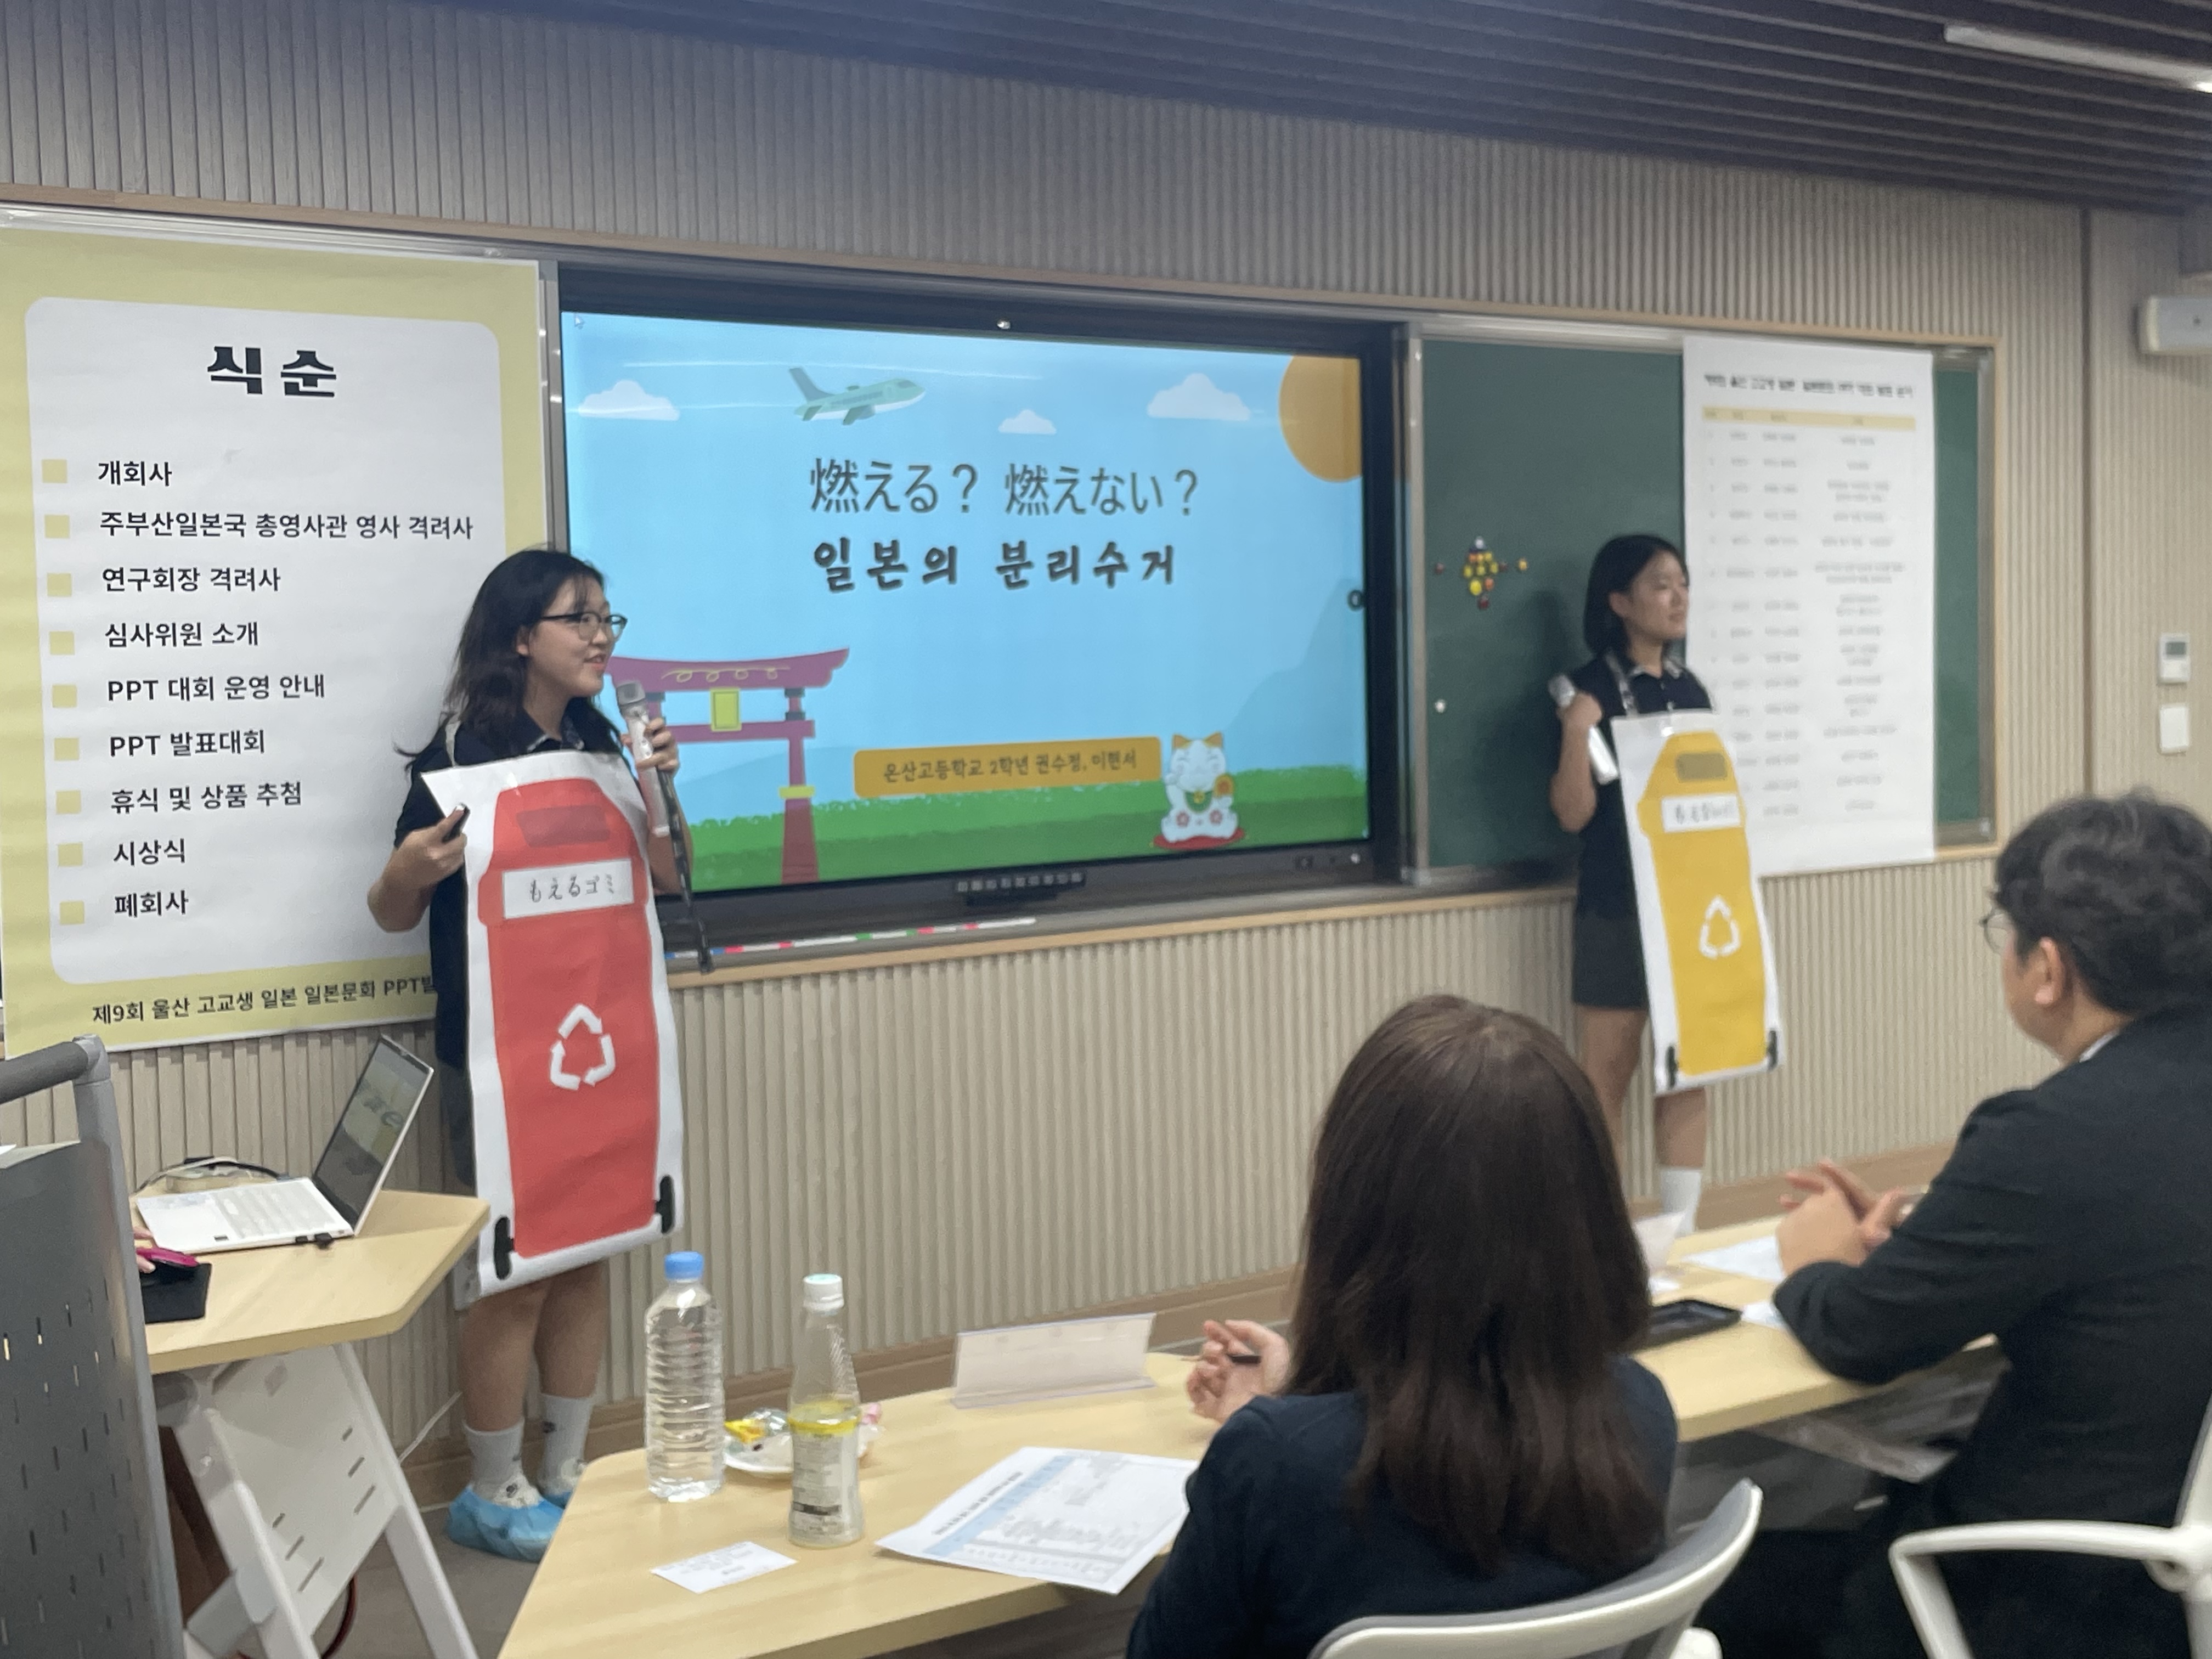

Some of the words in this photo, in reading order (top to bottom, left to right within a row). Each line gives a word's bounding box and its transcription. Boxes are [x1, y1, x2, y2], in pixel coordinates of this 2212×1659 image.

[98, 460, 172, 487] 개회사
[810, 458, 978, 513] 燃える？
[1005, 463, 1198, 516] 燃えない？
[100, 512, 247, 538] 주부산일본국
[255, 514, 348, 539] 총영사관
[356, 515, 400, 539] 영사
[409, 516, 473, 540] 격려사
[814, 537, 957, 593] 일본의
[995, 540, 1173, 590] 분리수거
[103, 567, 201, 592] 연구회장
[210, 567, 281, 592] 격려사
[105, 622, 202, 648] 심사위원
[212, 622, 258, 646] 소개
[108, 680, 159, 701] PPT
[168, 676, 214, 702] 대회
[224, 675, 269, 700] 운영
[279, 674, 324, 698] 안내
[110, 735, 161, 757] PPT
[170, 729, 264, 757] 발표대회
[883, 757, 984, 783] 온산고등학교
[989, 754, 1029, 777] 2학년
[111, 788, 158, 814] 휴식
[170, 786, 191, 811] 및
[201, 784, 247, 809] 상품
[256, 781, 301, 806] 추첨
[113, 838, 185, 866] 시상식
[115, 890, 189, 918] 폐회사
[93, 1001, 144, 1024] 제9회
[151, 997, 190, 1020] 울산
[197, 991, 253, 1013] 고교생
[261, 988, 297, 1009] 일본
[304, 980, 375, 1006] 일본문화
